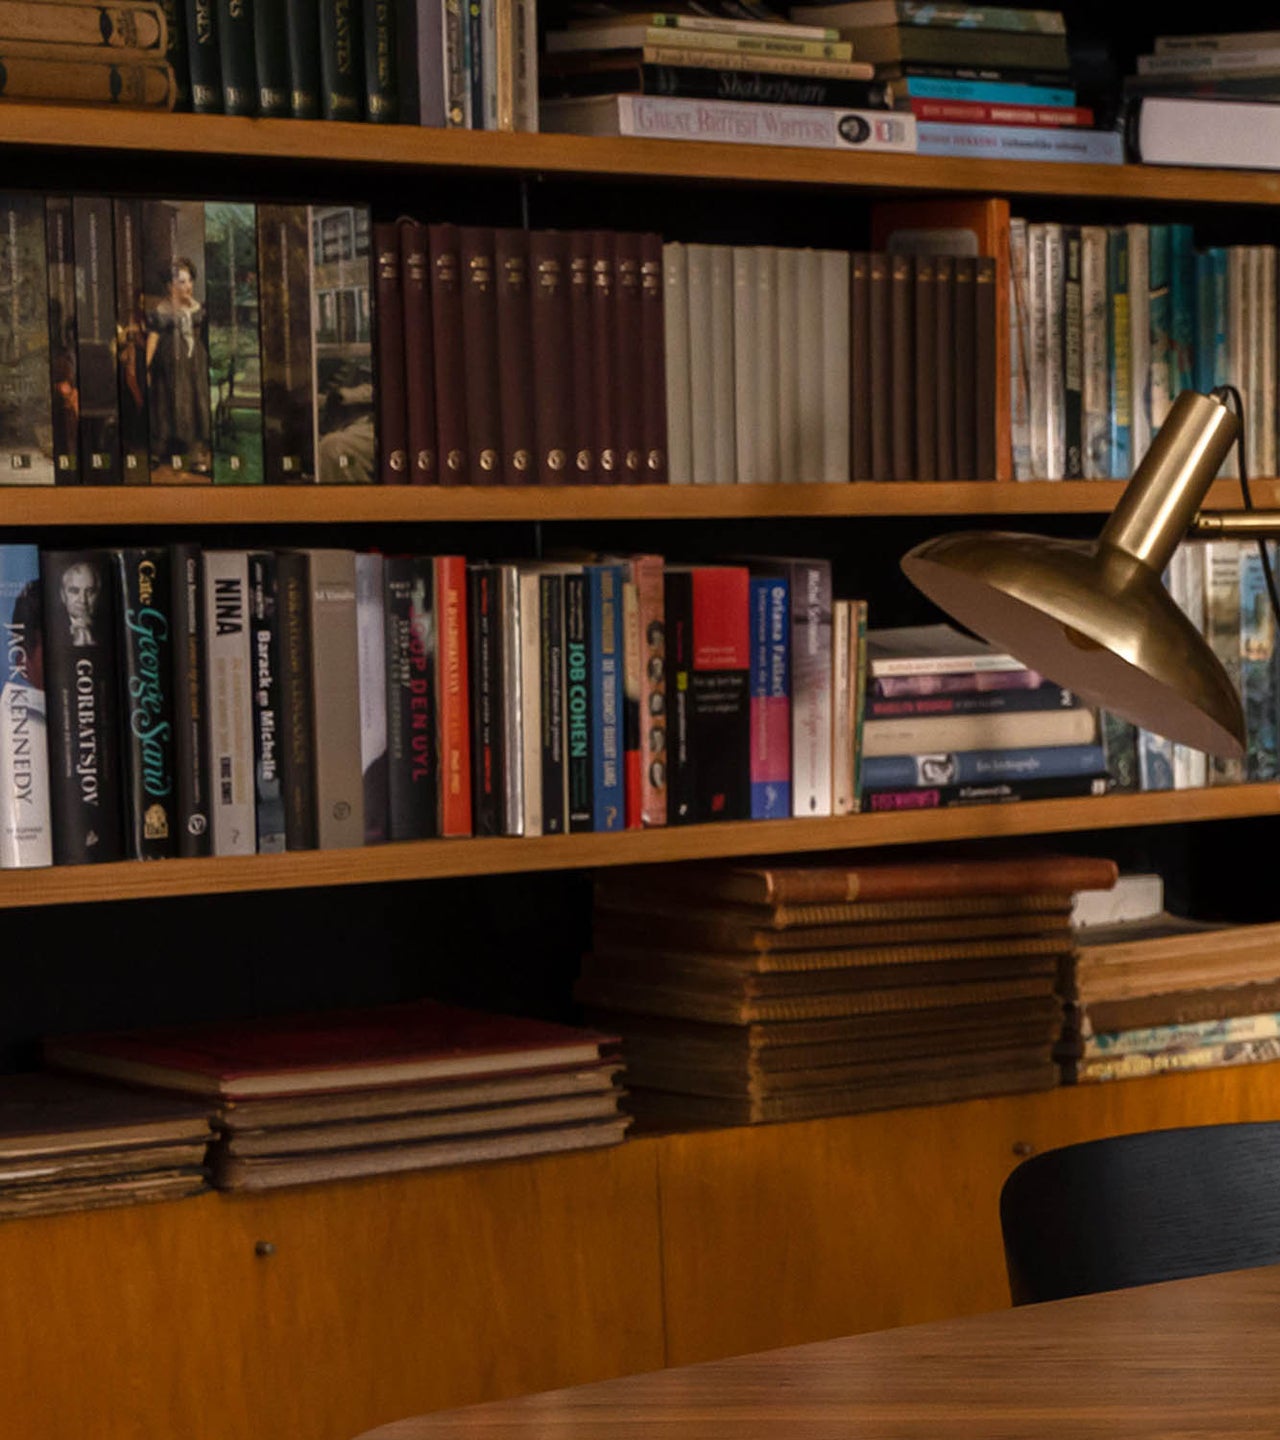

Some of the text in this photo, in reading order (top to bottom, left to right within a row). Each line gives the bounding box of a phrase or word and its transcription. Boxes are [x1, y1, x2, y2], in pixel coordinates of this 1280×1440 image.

[215, 578, 243, 638] NINA
[2, 622, 33, 805] JACK KENNEDY
[76, 659, 100, 807] GORBATSJOV
[125, 608, 173, 797] George Sand
[257, 630, 277, 780] Barack Michelle
[411, 680, 429, 783] DEN UYL
[569, 642, 588, 758] JOB COHEN
